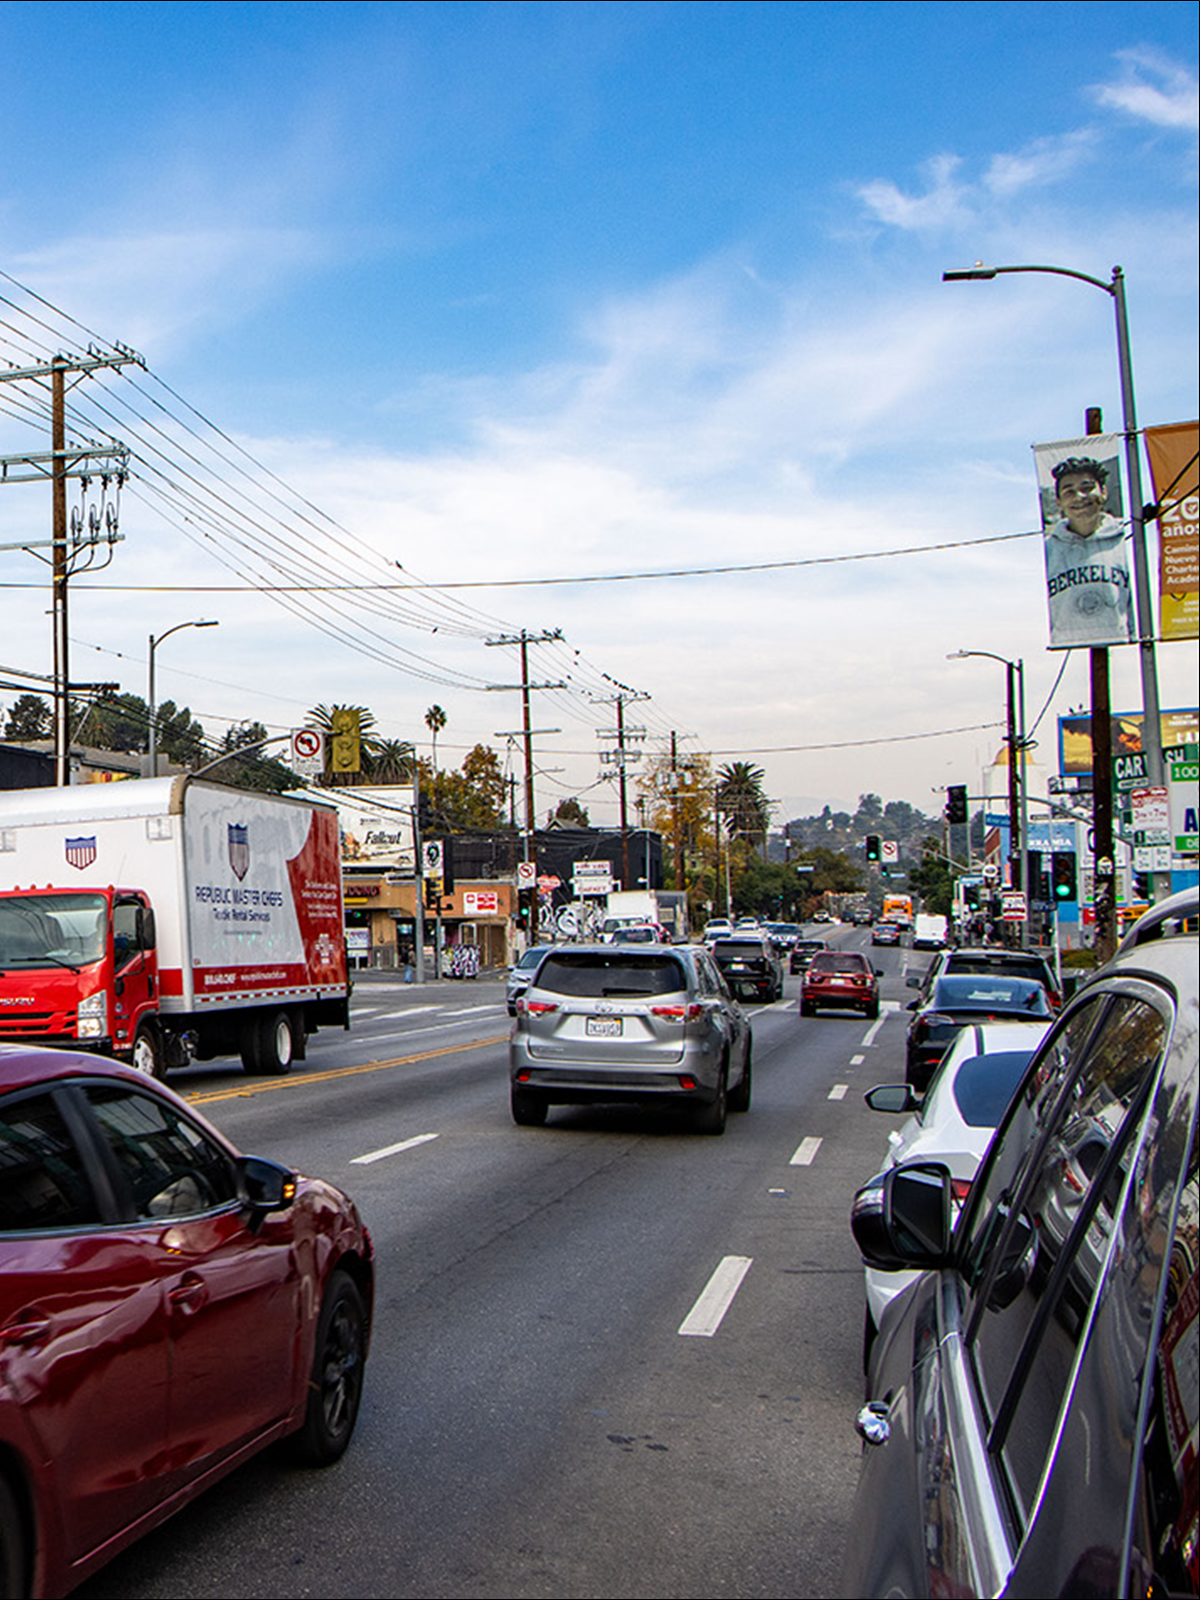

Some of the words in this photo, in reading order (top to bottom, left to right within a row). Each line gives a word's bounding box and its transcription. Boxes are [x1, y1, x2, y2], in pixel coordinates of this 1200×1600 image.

[1165, 565, 1199, 575] Charte
[1047, 564, 1130, 599] BERKELEY
[1114, 754, 1144, 779] CAR
[196, 886, 231, 904] REPUBLIC
[233, 889, 260, 906] MASTER
[0, 997, 35, 1006] ISUZU
